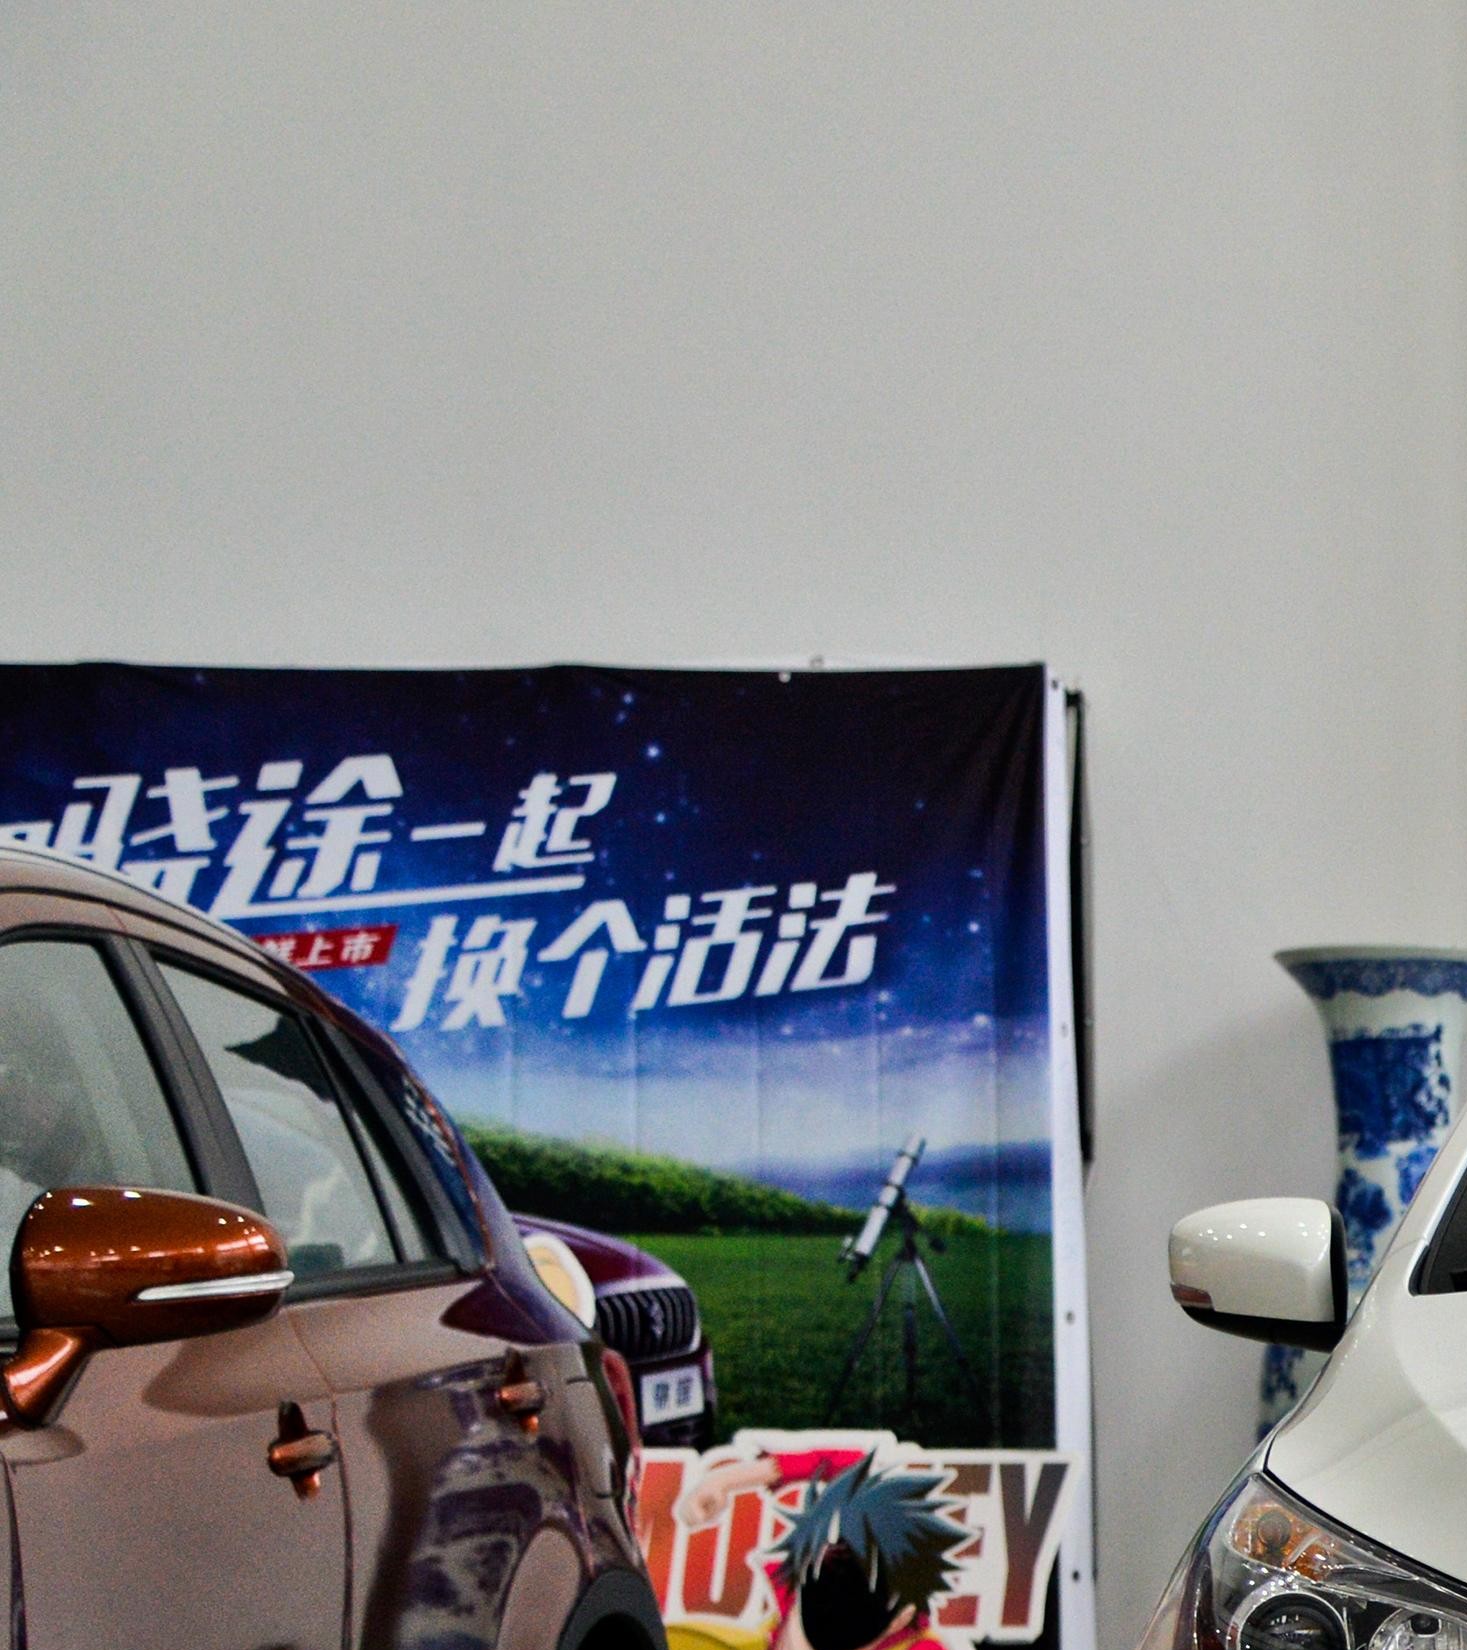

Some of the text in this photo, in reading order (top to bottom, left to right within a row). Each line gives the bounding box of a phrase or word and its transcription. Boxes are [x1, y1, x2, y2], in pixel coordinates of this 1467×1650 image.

[0, 753, 617, 918] 骁途一起
[389, 871, 897, 1032] 换个活法
